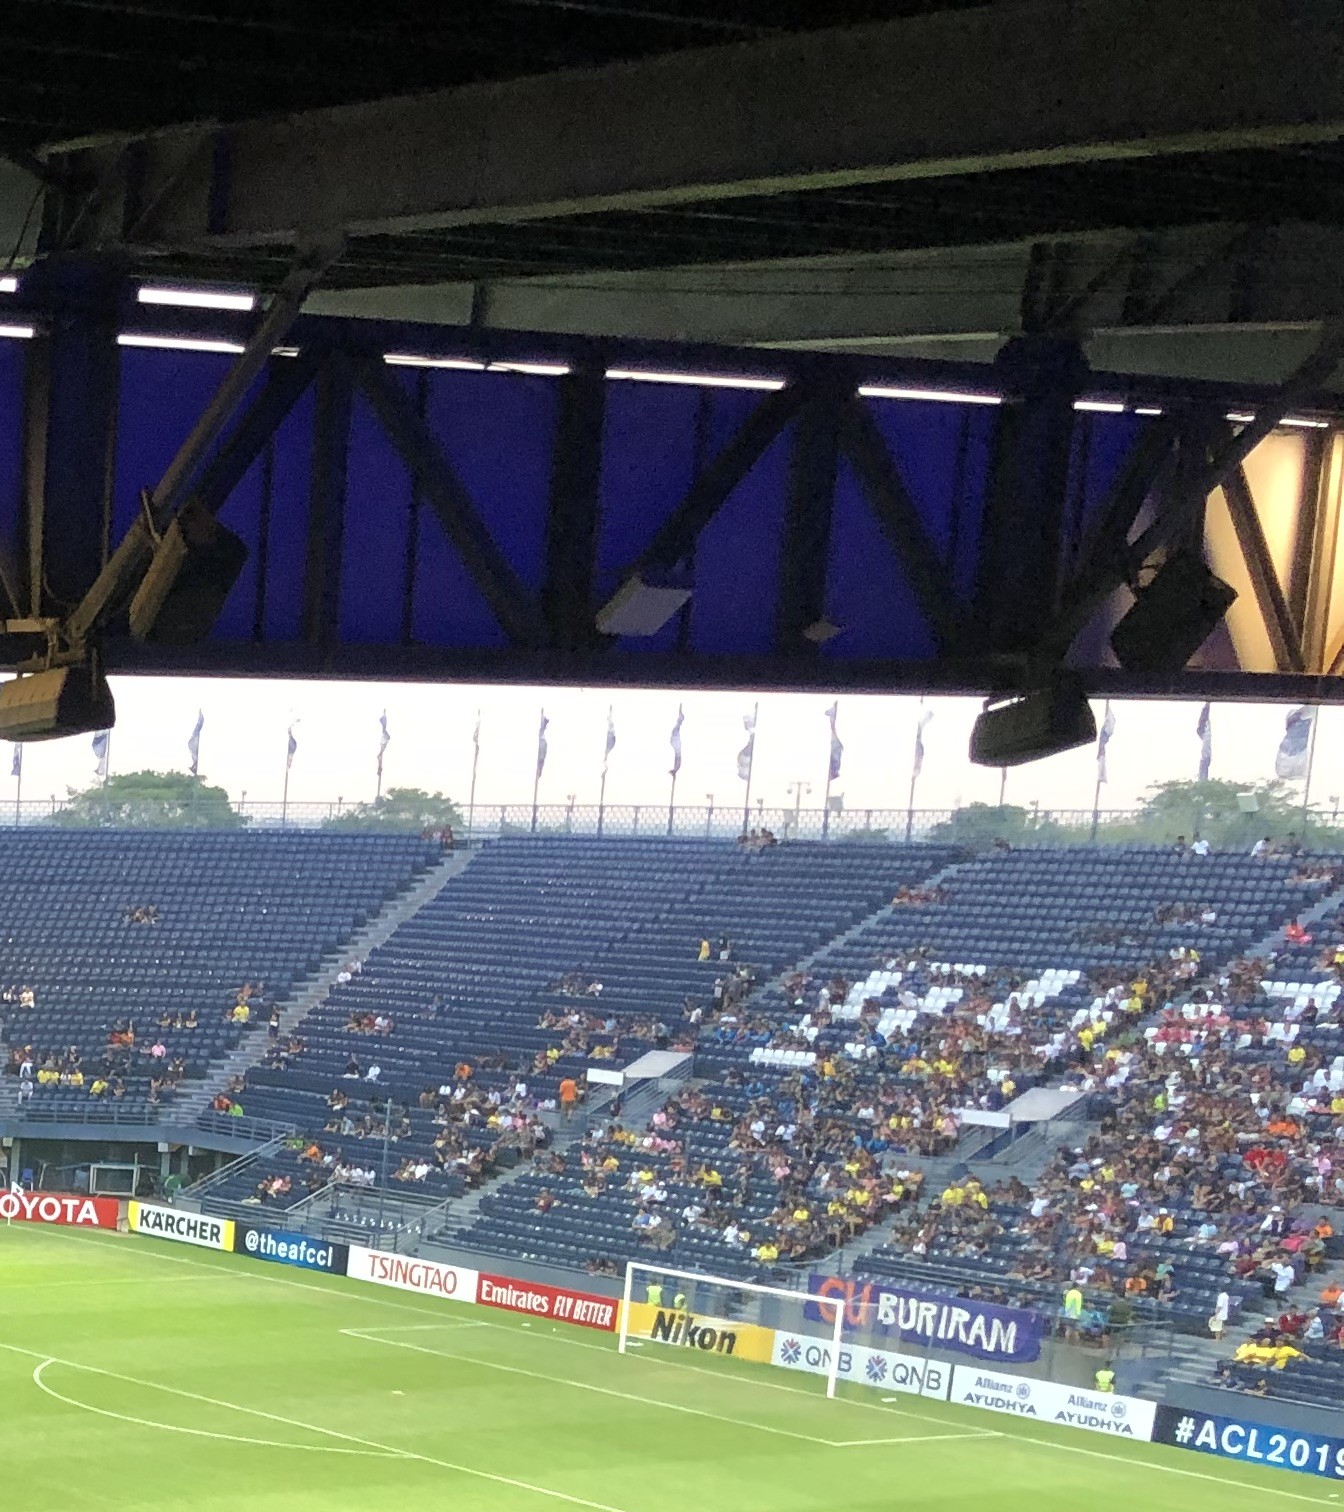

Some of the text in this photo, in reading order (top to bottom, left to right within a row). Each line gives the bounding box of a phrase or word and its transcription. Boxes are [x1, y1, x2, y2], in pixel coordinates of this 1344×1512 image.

[139, 1208, 221, 1244] KÄRCHER
[245, 1230, 333, 1267] @theafccl
[369, 1255, 457, 1294] TSINGTAO
[482, 1280, 613, 1326] Emirates FLY BETTER
[651, 1311, 736, 1354] Nikon
[877, 1292, 1017, 1354] BURIRAM
[892, 1362, 942, 1391] QNB
[975, 1376, 1013, 1394] Allianz
[964, 1392, 1037, 1416] AYUDHYA
[1067, 1394, 1107, 1412] Allianz
[1054, 1411, 1133, 1435] AYUDHYA
[1175, 1416, 1344, 1476] #ACL2019
